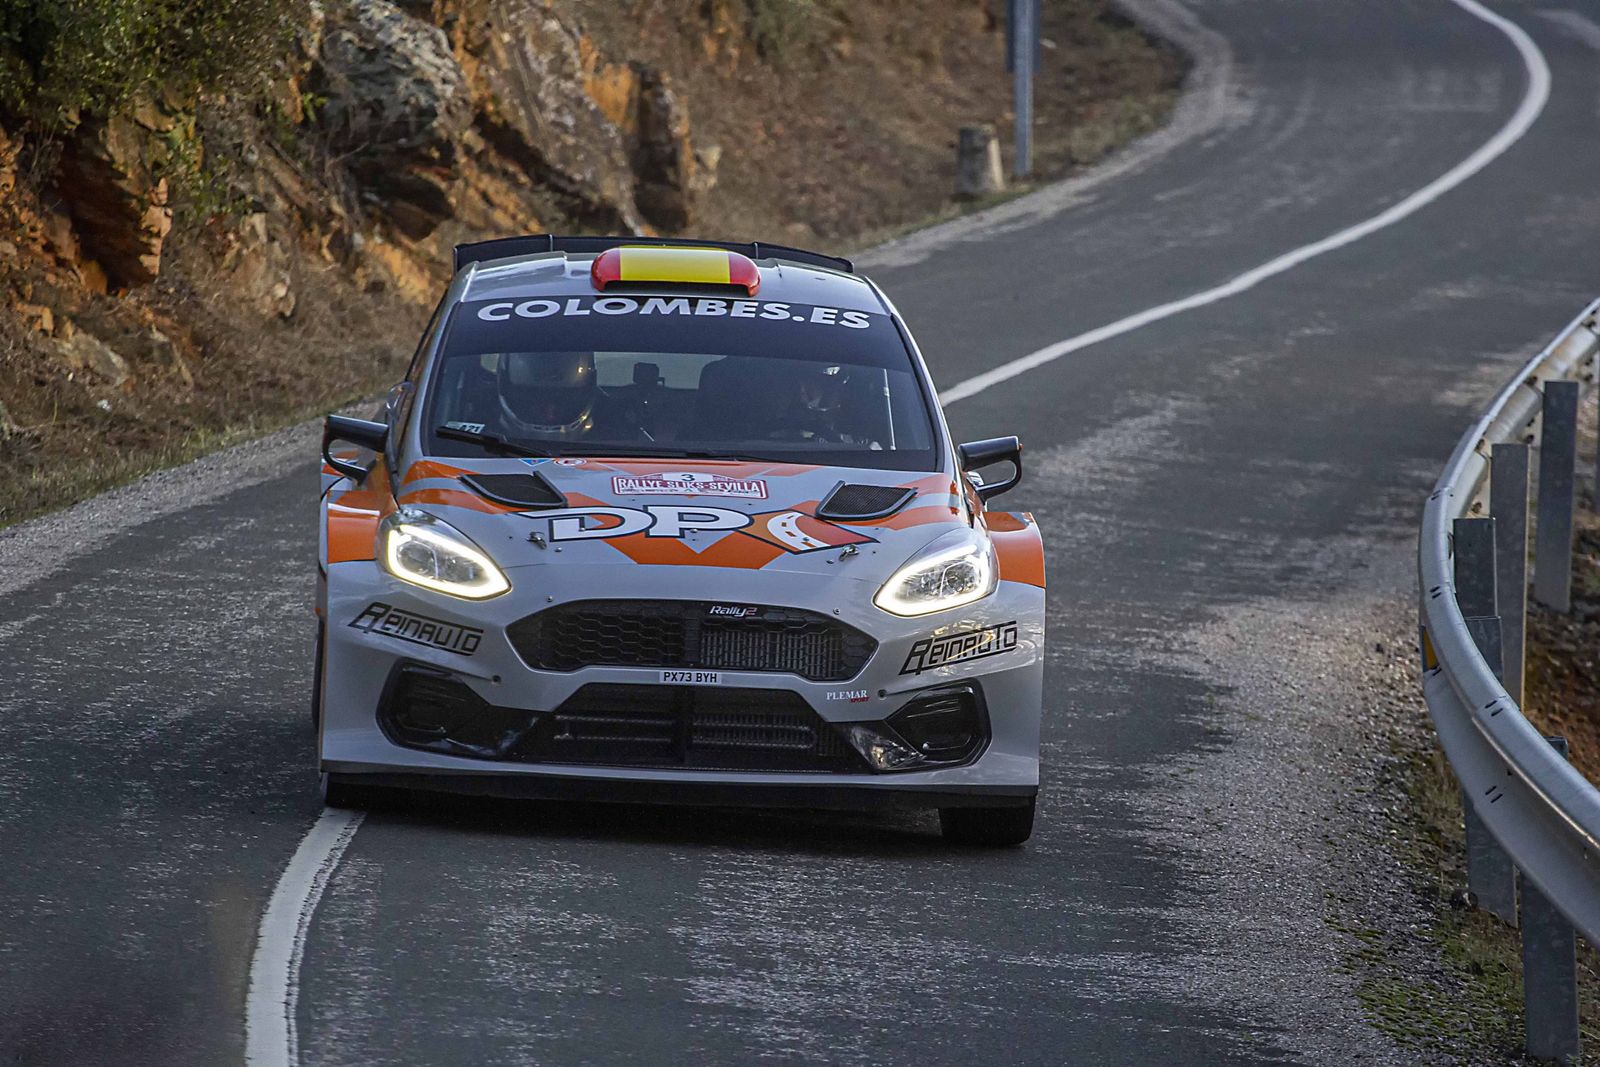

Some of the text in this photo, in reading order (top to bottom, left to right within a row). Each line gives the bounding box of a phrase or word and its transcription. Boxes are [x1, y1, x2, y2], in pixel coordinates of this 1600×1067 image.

[477, 297, 871, 330] COLOMBES.ES
[680, 473, 696, 482] 3
[617, 478, 664, 490] RALLYE
[709, 605, 758, 617] Rally2
[663, 671, 717, 683] PX73 BYH
[826, 689, 868, 701] PLEMAR
